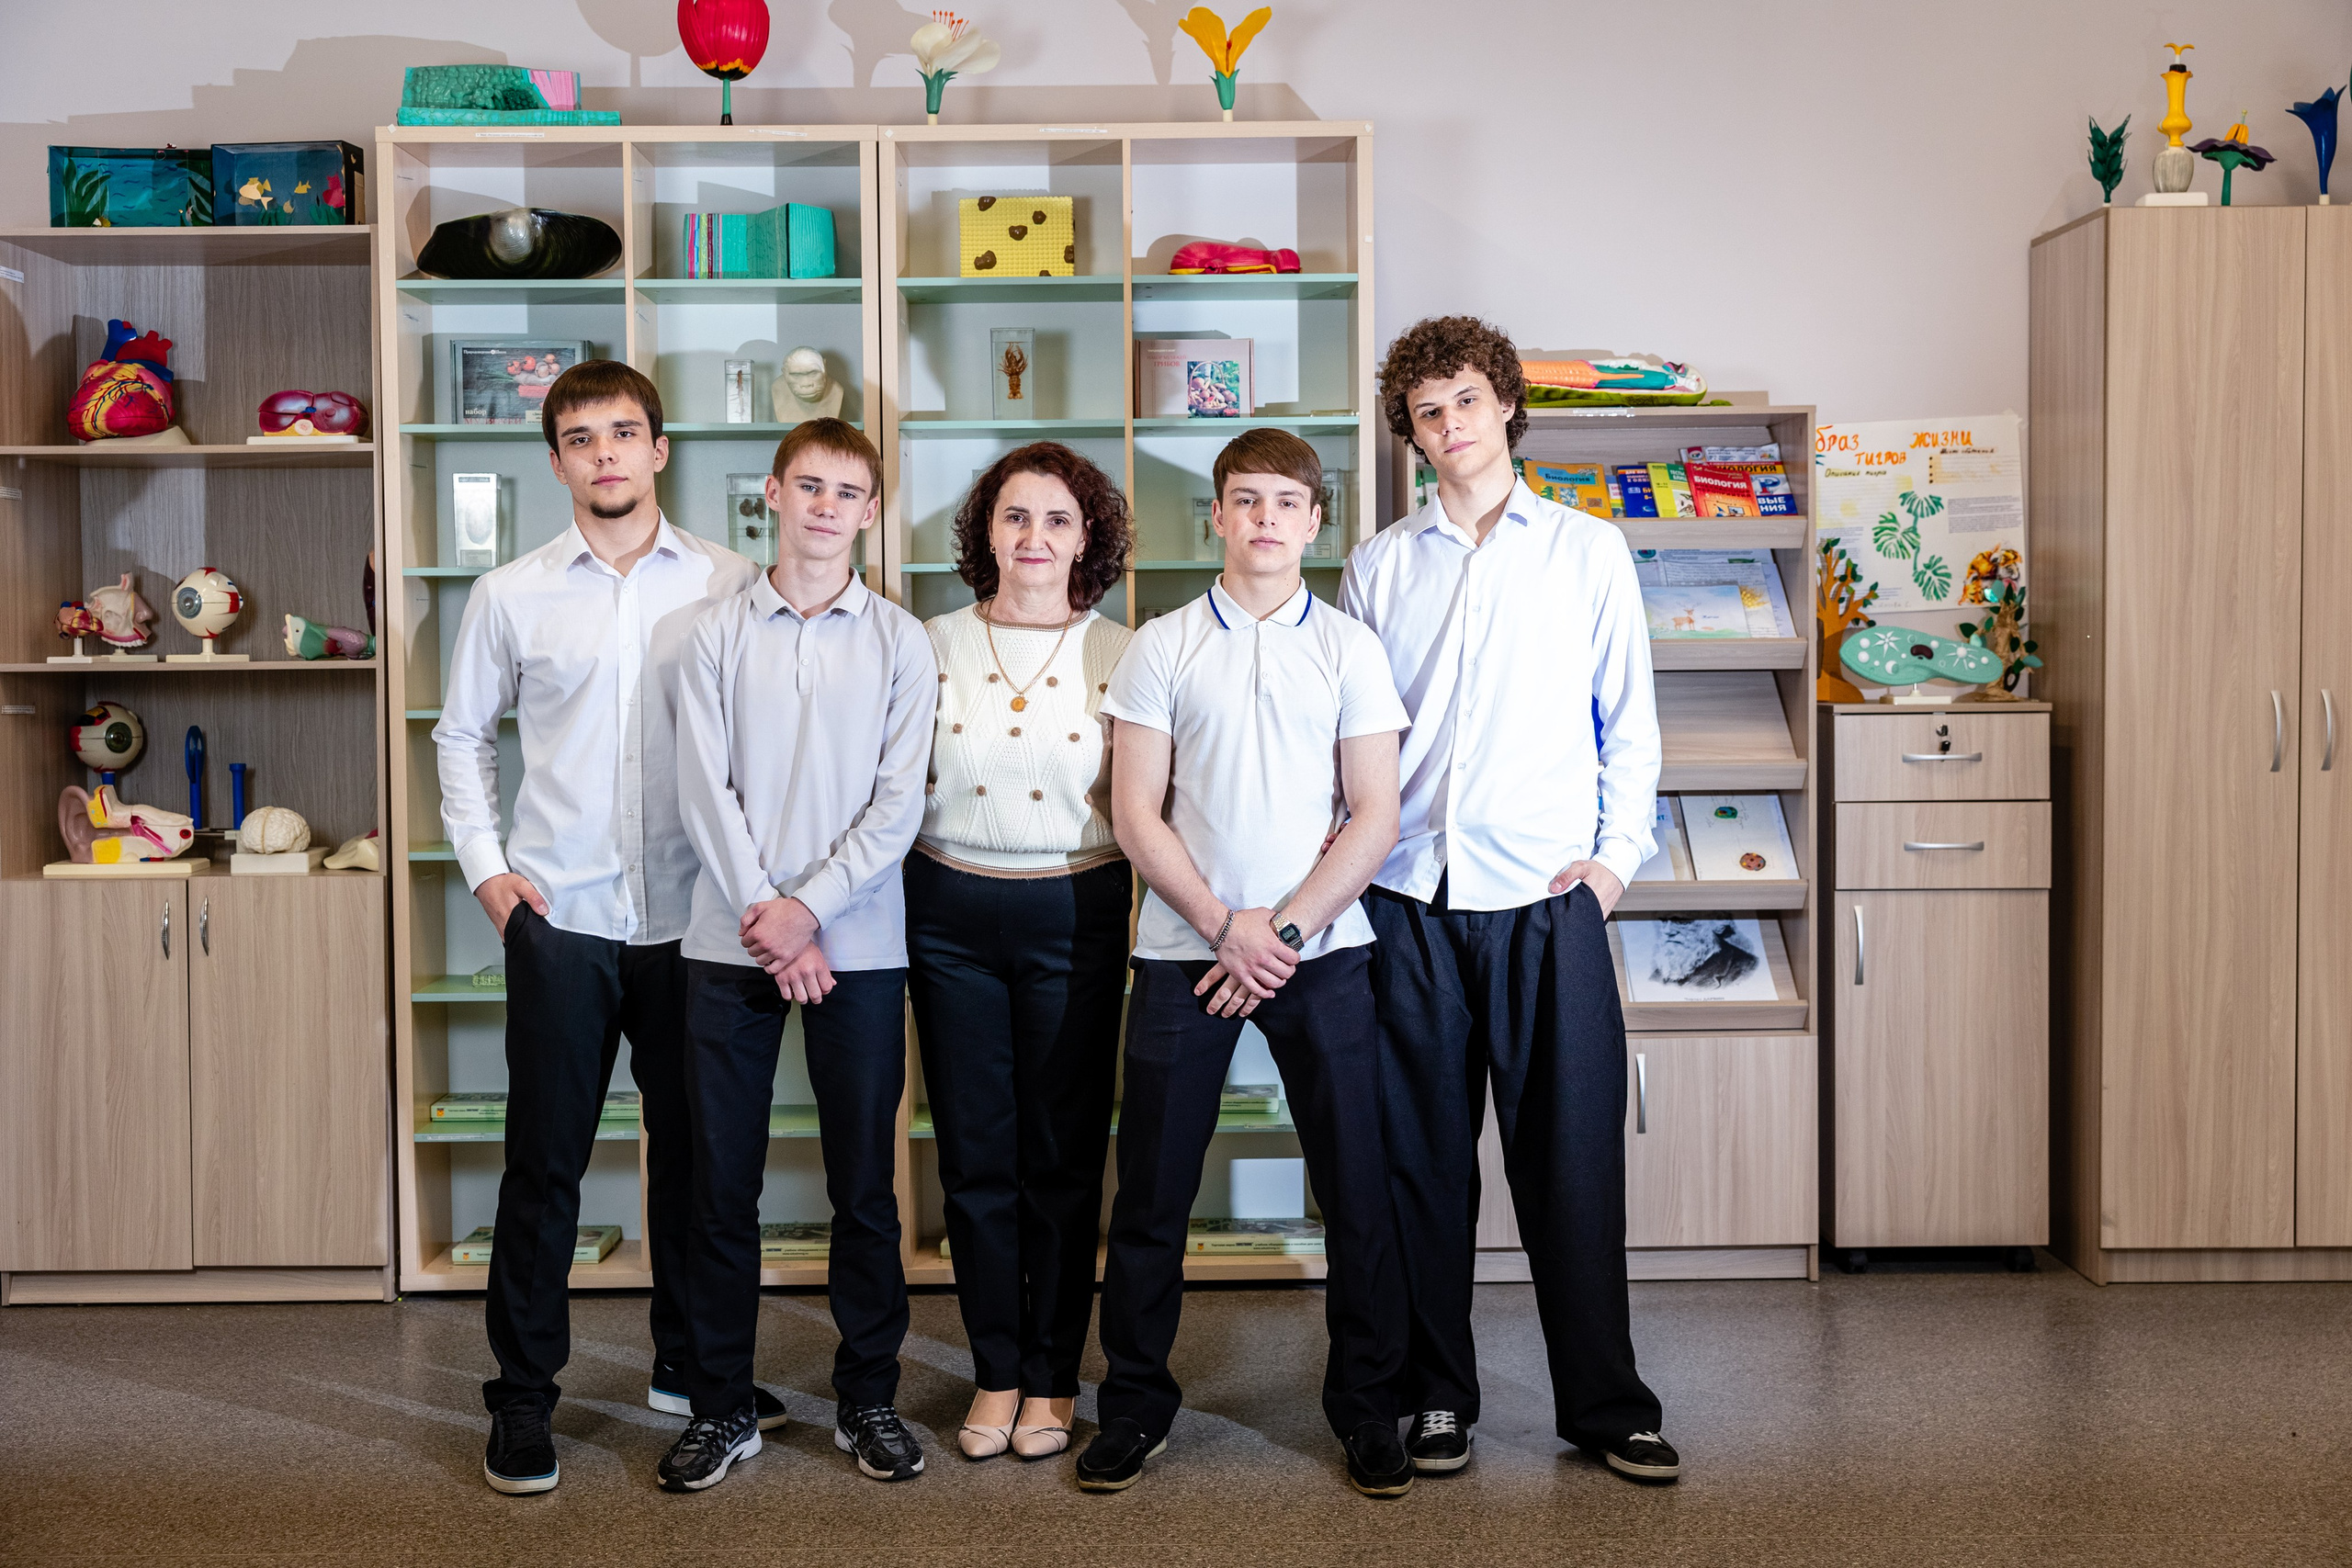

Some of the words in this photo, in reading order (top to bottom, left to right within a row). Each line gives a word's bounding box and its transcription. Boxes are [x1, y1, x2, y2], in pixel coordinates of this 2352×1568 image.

[465, 408, 487, 416] набор
[1545, 473, 1590, 482] Биология
[1693, 476, 1747, 490] БИОЛОГИЯ
[1758, 496, 1786, 504] ВЫЕ
[1760, 504, 1787, 513] НИЯ
